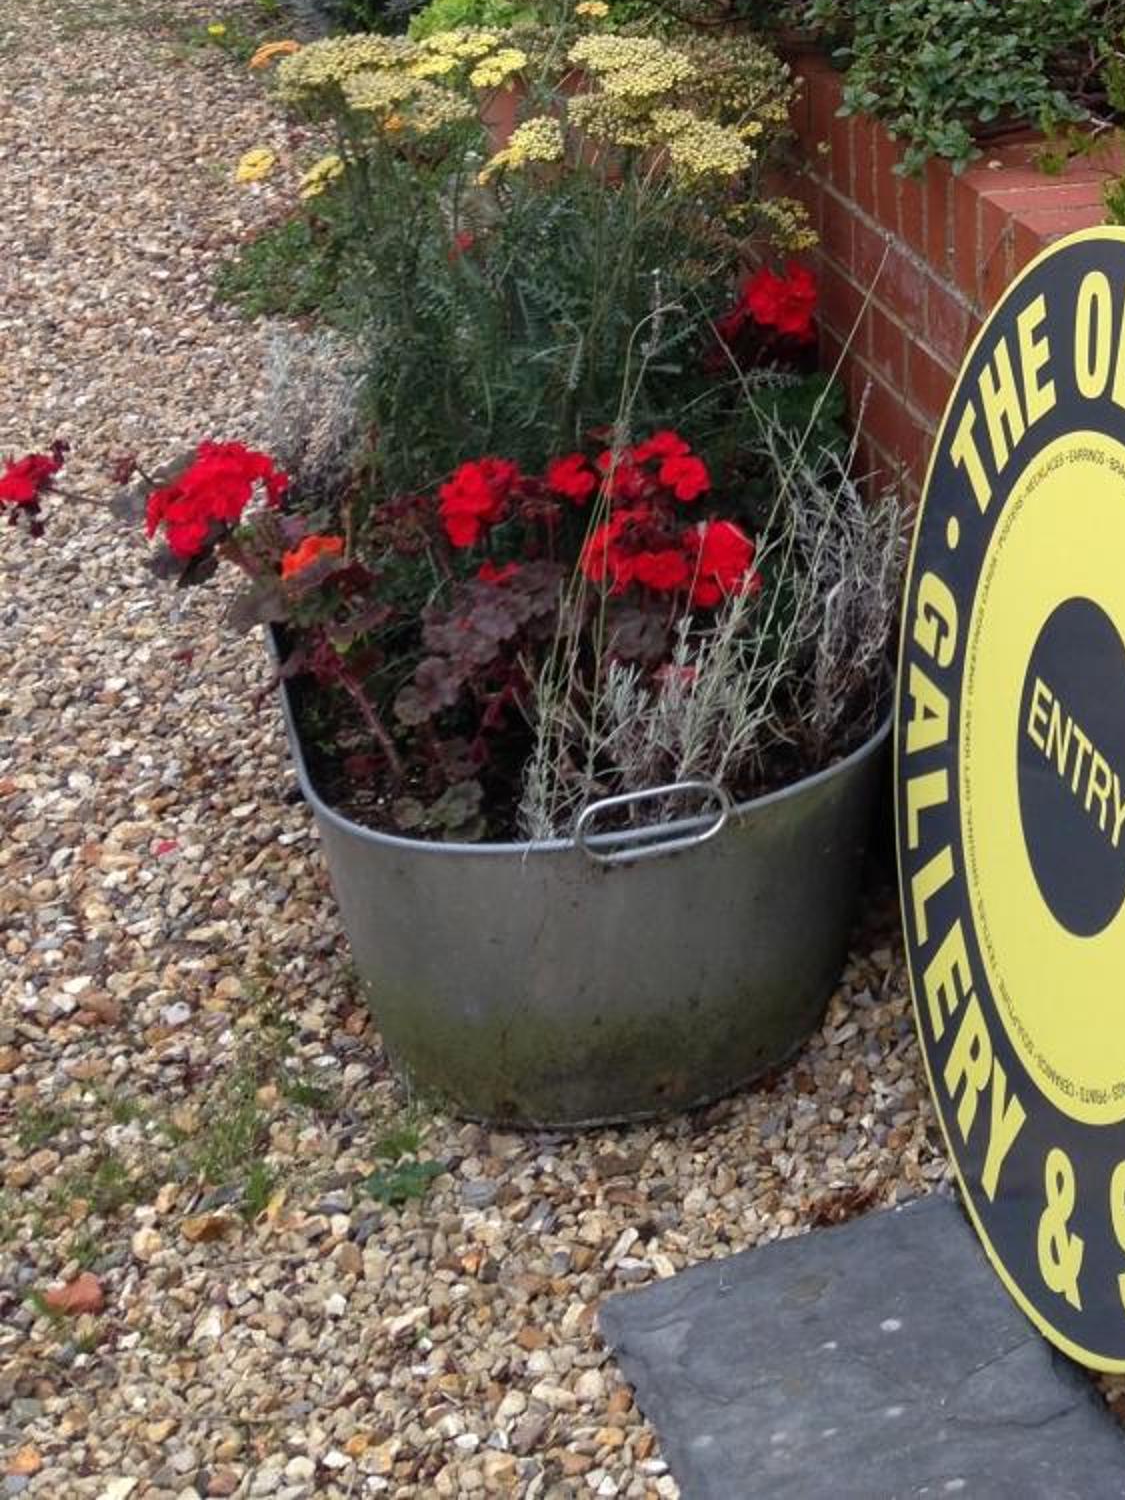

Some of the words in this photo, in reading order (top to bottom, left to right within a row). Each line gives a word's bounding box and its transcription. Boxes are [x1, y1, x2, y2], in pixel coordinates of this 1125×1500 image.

[950, 293, 1057, 514] THE
[905, 571, 1026, 1201] GALLERY
[1037, 1147, 1084, 1311] &
